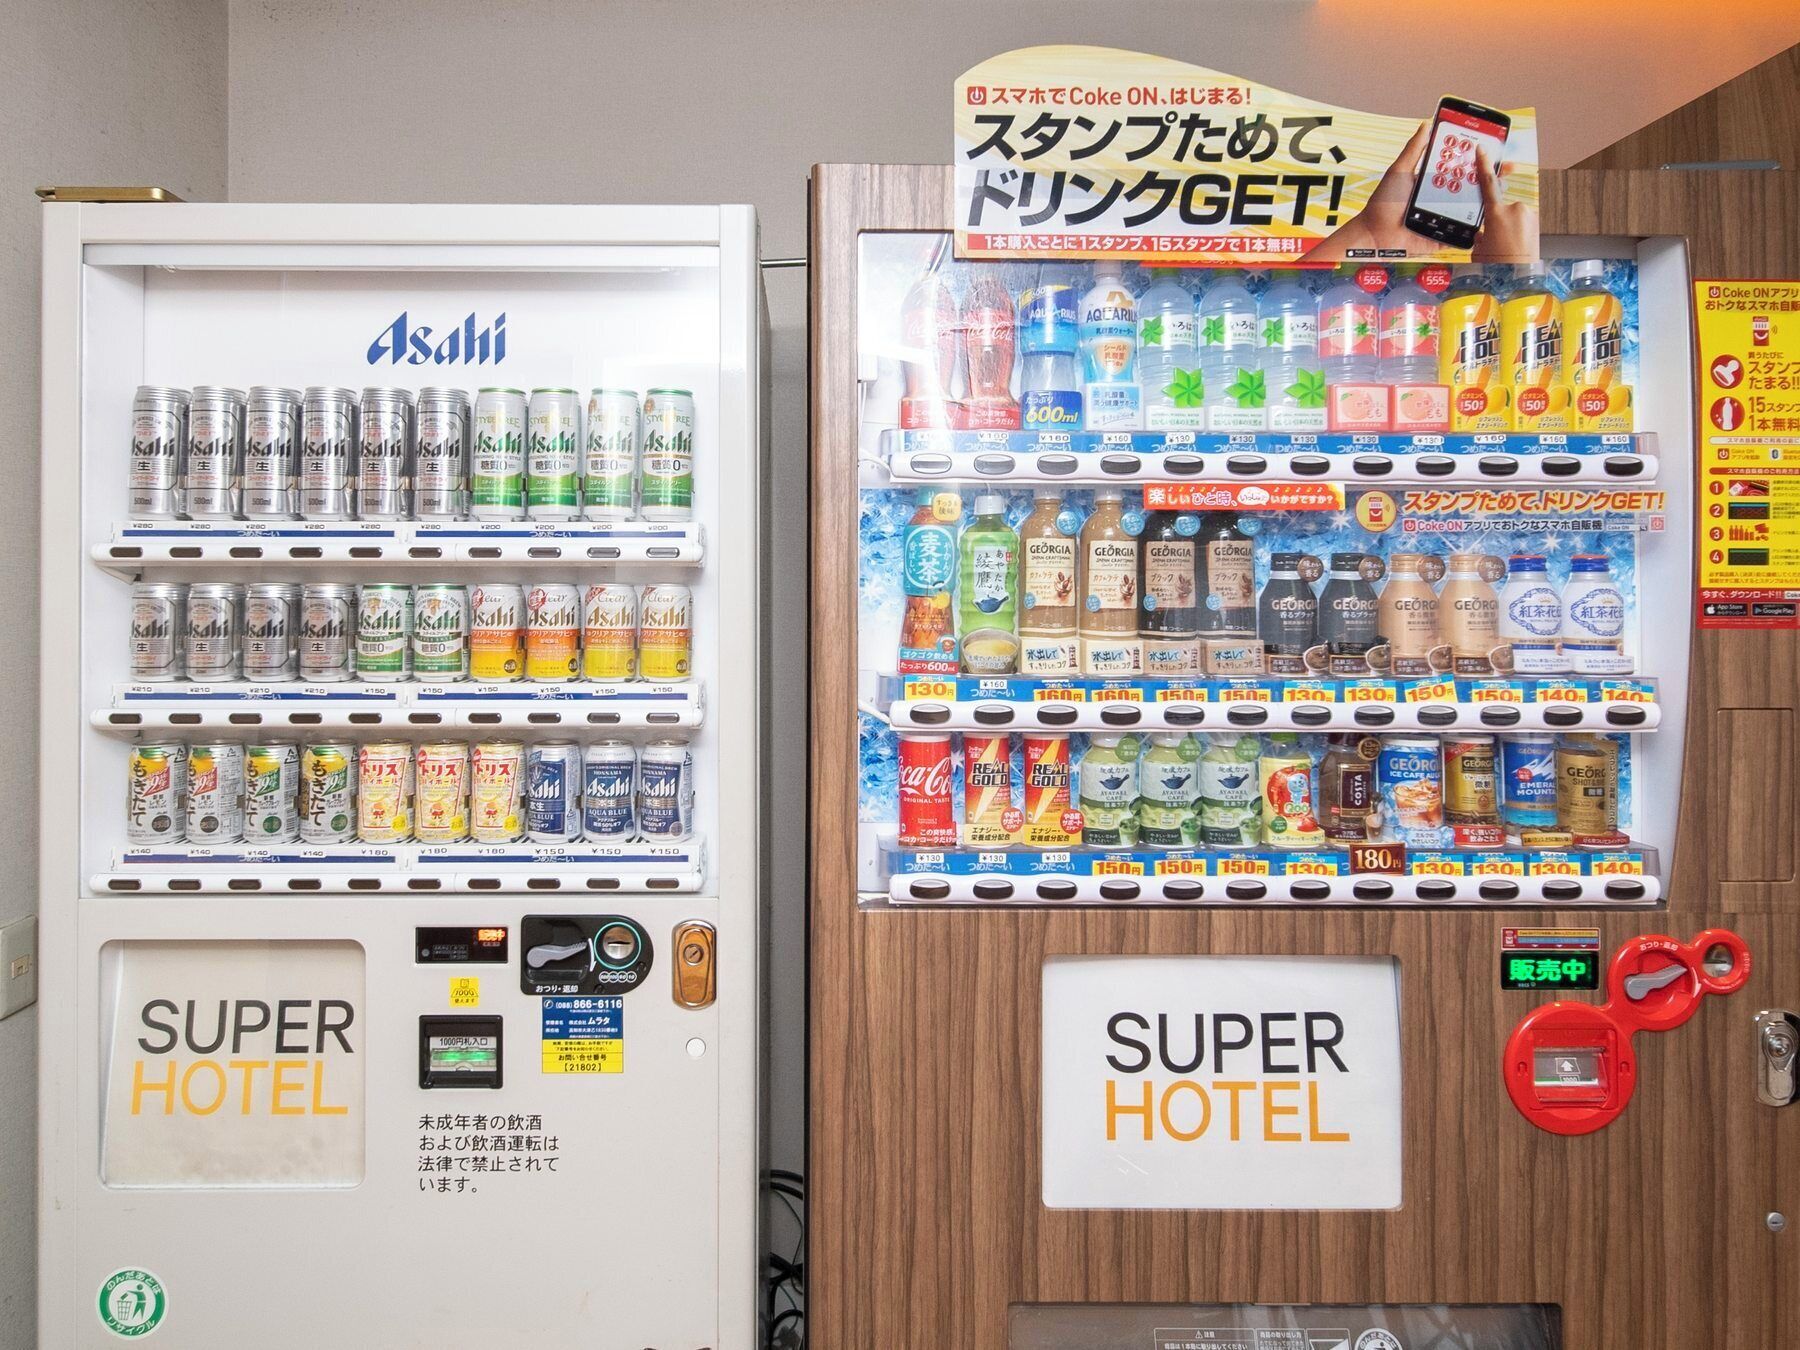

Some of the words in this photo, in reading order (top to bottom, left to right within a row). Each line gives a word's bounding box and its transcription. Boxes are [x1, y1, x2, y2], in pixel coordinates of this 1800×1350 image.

[967, 111, 1347, 164] スタンプためて、
[968, 170, 1346, 228] ドリンクGET!
[1723, 288, 1750, 298] Coke
[367, 311, 506, 365] Asahi
[644, 430, 692, 455] Asahi
[1403, 490, 1664, 514] スタンプためて、ドリンクGET!
[1418, 521, 1444, 531] Coke
[1030, 542, 1071, 554] GEORGIA
[1095, 544, 1135, 557] GEORGIA
[1151, 545, 1192, 557] GEORGIA
[529, 606, 575, 627] Asahi
[587, 606, 634, 627] Asahi
[973, 758, 1008, 774] REAL
[1033, 759, 1068, 775] REAL
[588, 776, 630, 798] Asahi
[972, 774, 1008, 787] GOLD
[1032, 775, 1068, 788] GOLD
[1354, 774, 1363, 806] COSTA
[919, 854, 941, 862] ¥130
[982, 854, 1004, 862] ¥130
[1045, 854, 1067, 862] ¥130
[1509, 958, 1586, 981] 販売中
[573, 999, 623, 1009] 866-6116
[137, 998, 355, 1055] SUPER
[588, 1016, 611, 1026] ムラタ
[439, 1037, 488, 1046] 1000円札入口
[1105, 1011, 1350, 1074] SUPER
[131, 1060, 348, 1116] HOTEL
[1105, 1080, 1350, 1142] HOTEL
[418, 1114, 543, 1131] 未成年者の飲酒
[418, 1134, 560, 1152] および飲酒運転は
[417, 1155, 560, 1172] 法律で禁止されて
[418, 1176, 478, 1193] います。
[106, 1316, 156, 1336] リサイクル
